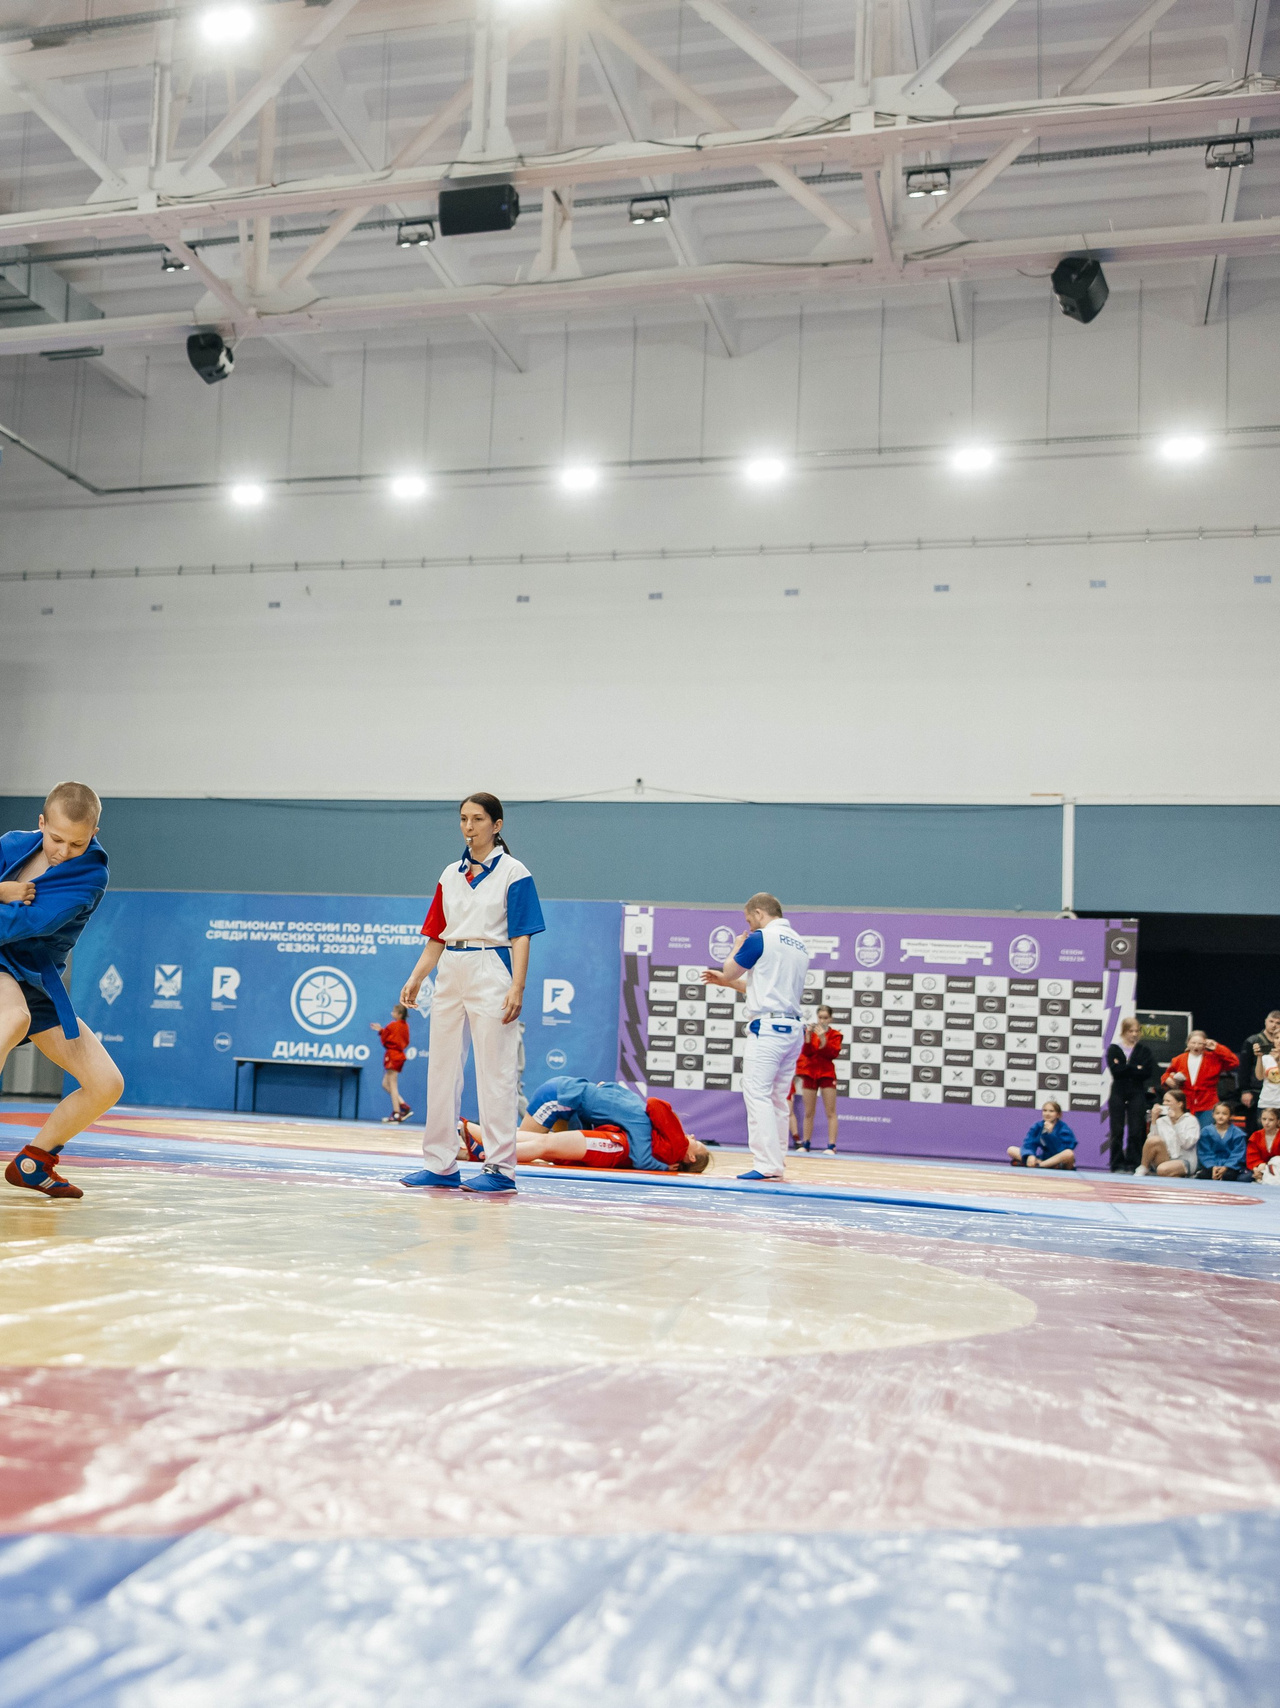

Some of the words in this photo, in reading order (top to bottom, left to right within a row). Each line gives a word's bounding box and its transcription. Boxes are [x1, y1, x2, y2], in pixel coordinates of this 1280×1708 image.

[209, 920, 284, 932] ЧЕМПИОНАТ
[287, 922, 340, 933] РОССИИ
[342, 923, 361, 934] ПО
[205, 930, 248, 942] СРЕДИ
[249, 932, 315, 943] МУЖСКИХ
[318, 934, 375, 945] КОМАНД
[276, 943, 320, 954] СЕЗОН
[322, 944, 377, 955] 2023/24
[272, 1040, 370, 1061] ДИНАМО
